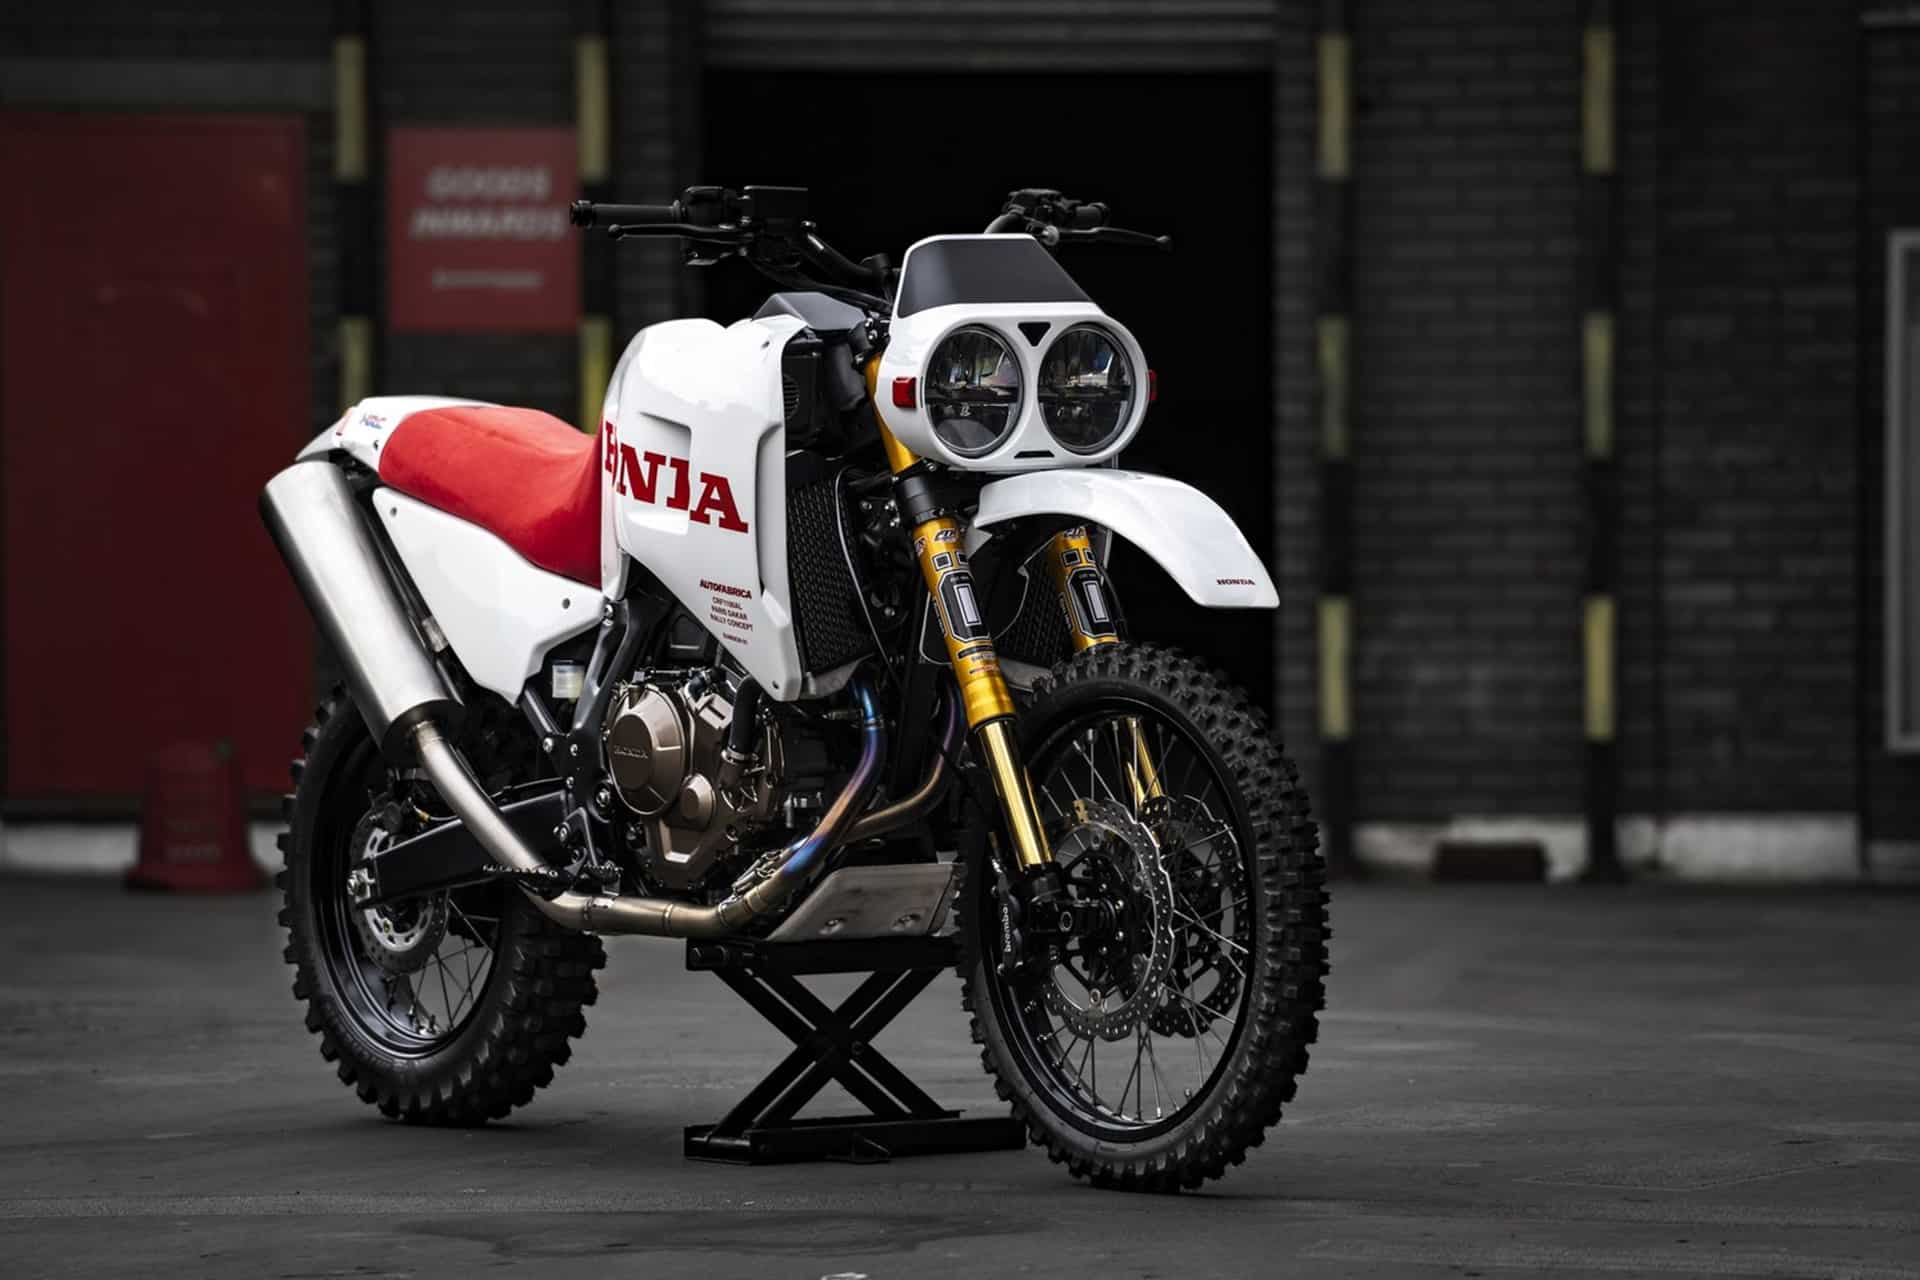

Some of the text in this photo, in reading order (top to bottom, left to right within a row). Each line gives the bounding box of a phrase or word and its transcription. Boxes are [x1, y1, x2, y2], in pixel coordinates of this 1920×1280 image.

[700, 579, 752, 599] AUTOFABRICA
[1216, 578, 1256, 586] HONDA
[727, 618, 753, 632] CONCEPT
[1001, 906, 1012, 953] brembo
